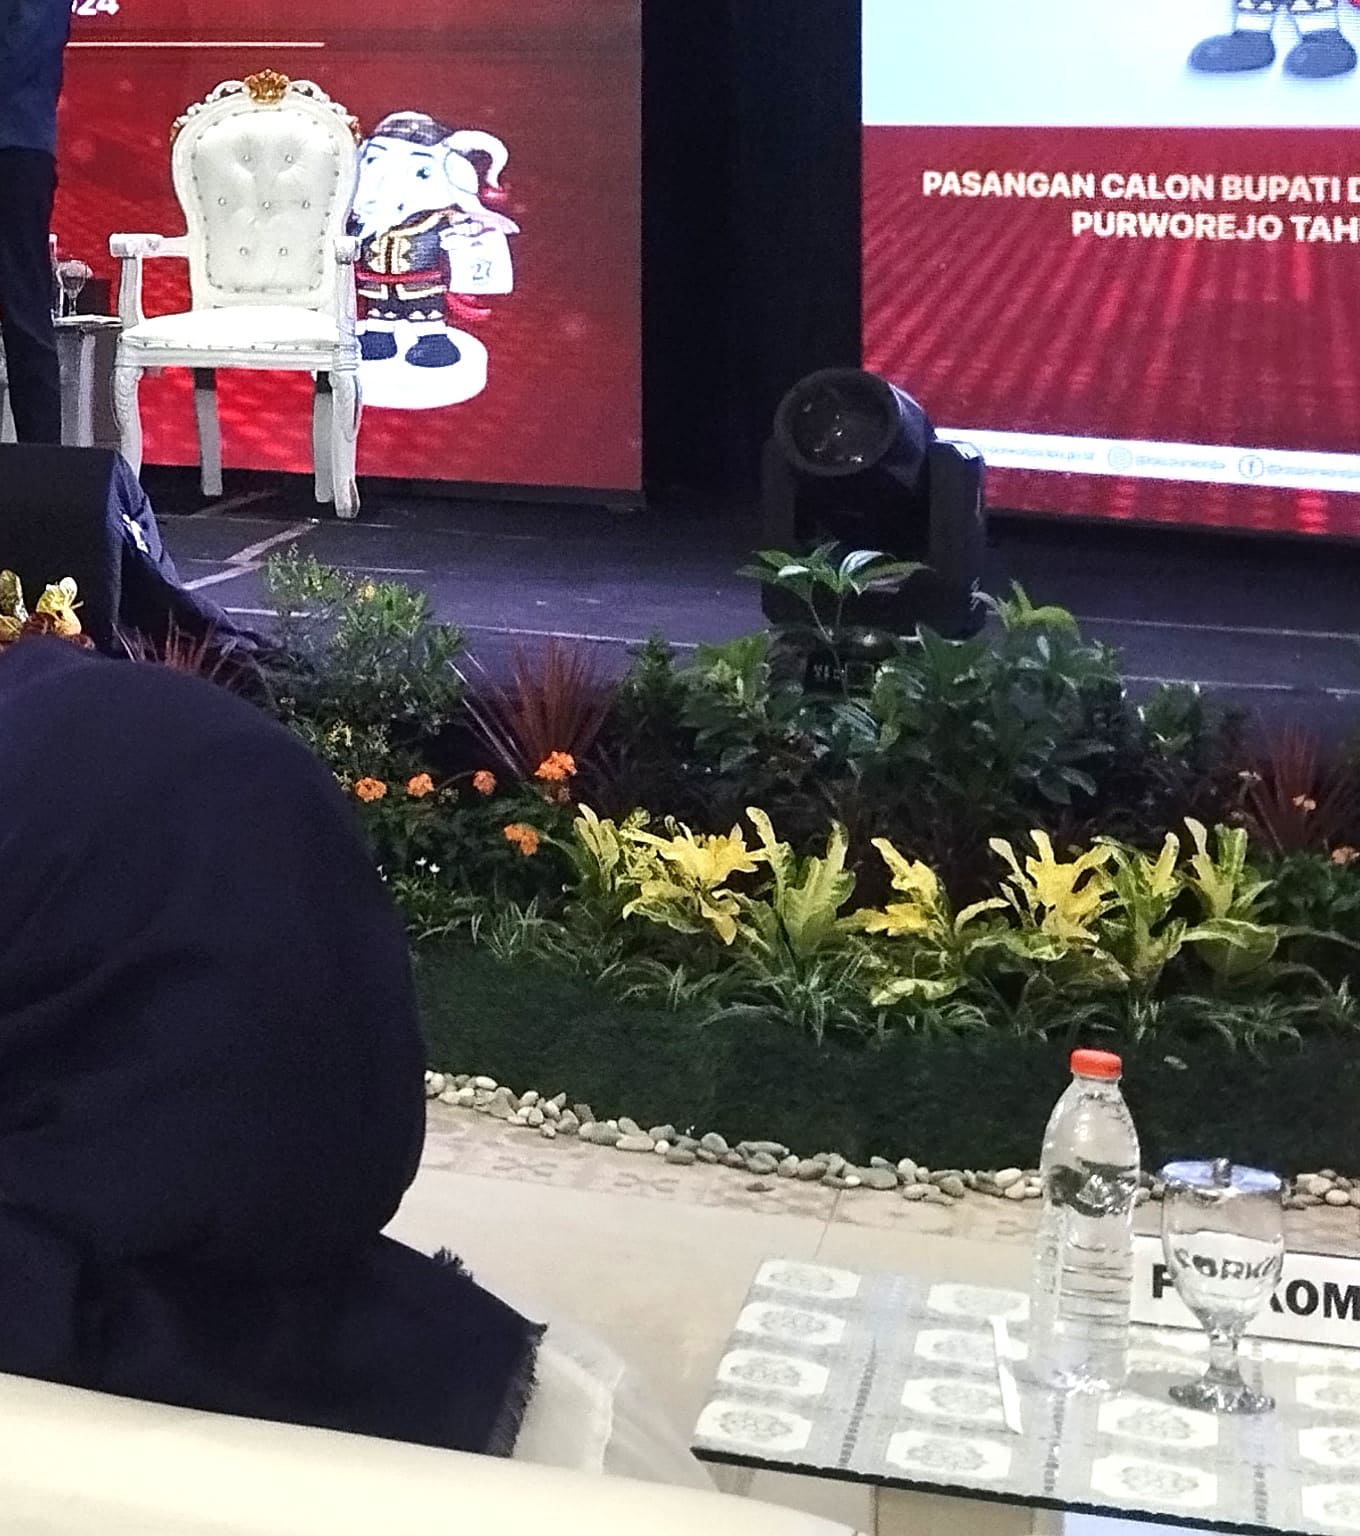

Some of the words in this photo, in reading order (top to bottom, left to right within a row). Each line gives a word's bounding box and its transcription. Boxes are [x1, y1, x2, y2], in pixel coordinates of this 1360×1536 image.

[922, 170, 1095, 199] PASANGAN
[1101, 173, 1214, 202] CALON
[1221, 175, 1341, 203] BUPATI
[1072, 210, 1283, 241] PURWOREJO
[1289, 215, 1360, 243] TAH
